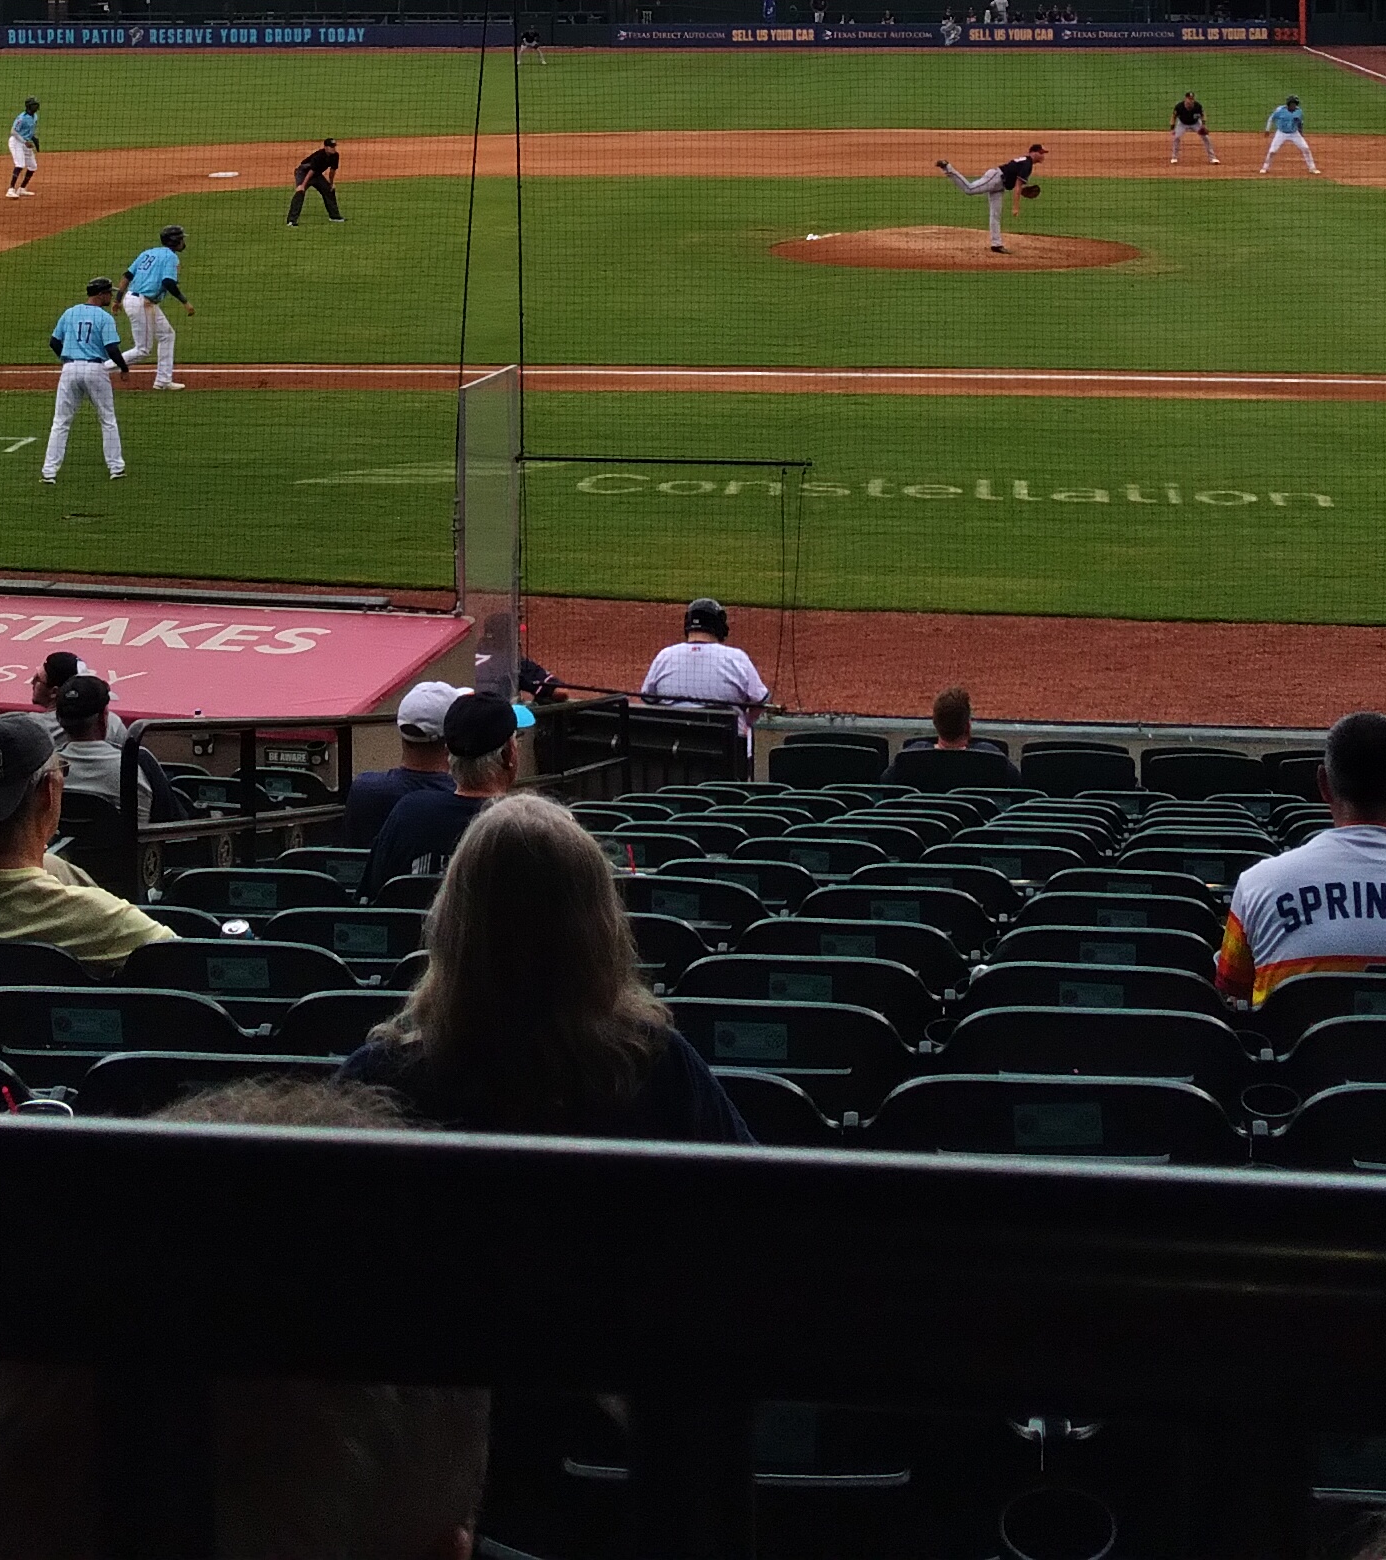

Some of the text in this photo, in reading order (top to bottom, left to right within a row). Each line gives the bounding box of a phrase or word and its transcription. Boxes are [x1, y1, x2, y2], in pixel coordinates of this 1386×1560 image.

[8, 28, 366, 44] BULLPEN PATIO RESERVE YOUR GROUP TODAY
[732, 29, 814, 41] SELL US YOUR CAR
[970, 29, 1054, 40] SELL US YOUR CAR
[1072, 28, 1268, 40] TEXAS DIRECT SELL US YOUR CAR
[77, 321, 93, 344] 17
[577, 473, 1335, 508] Constellation
[280, 752, 306, 762] AWARE
